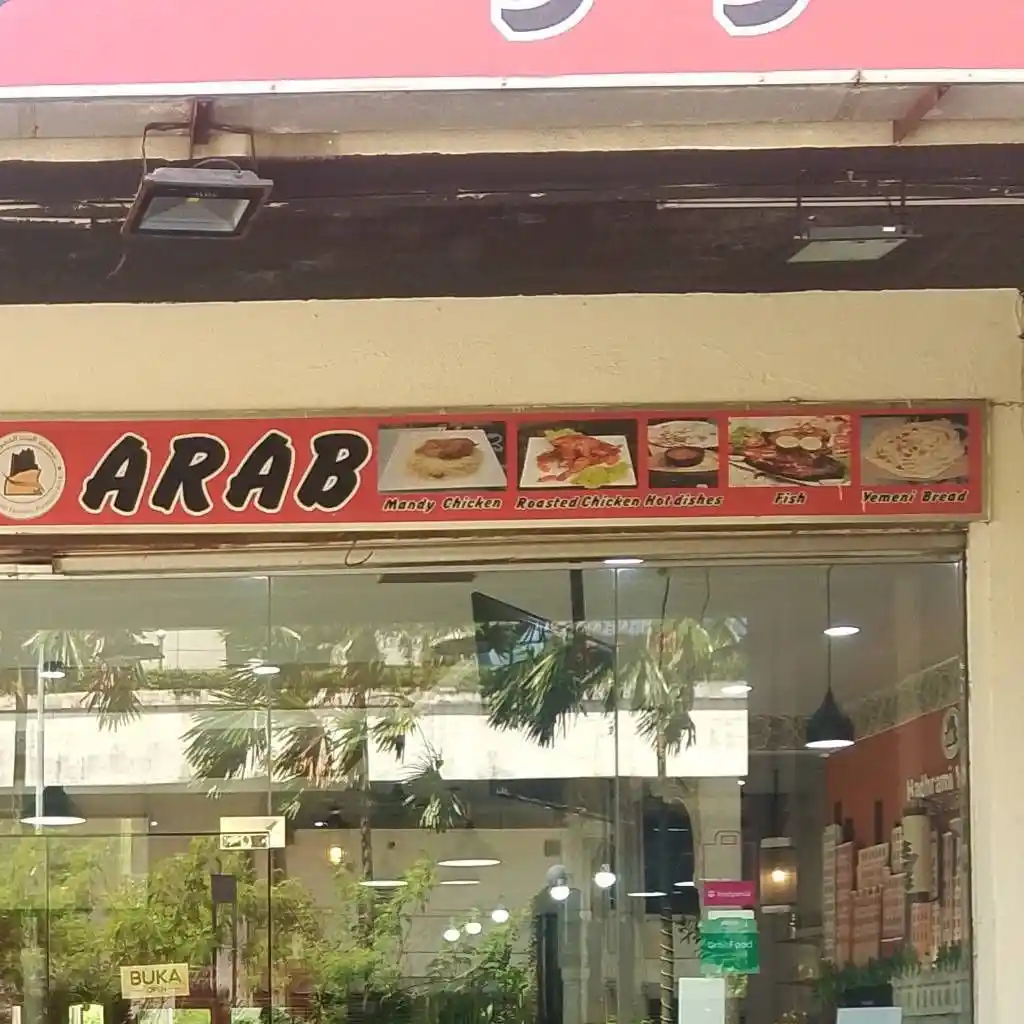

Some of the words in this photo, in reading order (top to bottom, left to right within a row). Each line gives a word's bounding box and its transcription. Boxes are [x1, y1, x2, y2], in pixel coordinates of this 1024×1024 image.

[78, 430, 374, 516] ARAB
[383, 497, 435, 512] Mandy
[443, 496, 502, 510] Chicken
[516, 496, 578, 510] Roasted
[580, 494, 641, 509] Chicken
[643, 493, 670, 507] Hot
[673, 492, 724, 507] dishes
[773, 491, 808, 505] Fish
[862, 490, 914, 504] Yemeni
[922, 489, 969, 503] Bread
[130, 968, 182, 986] BUKA
